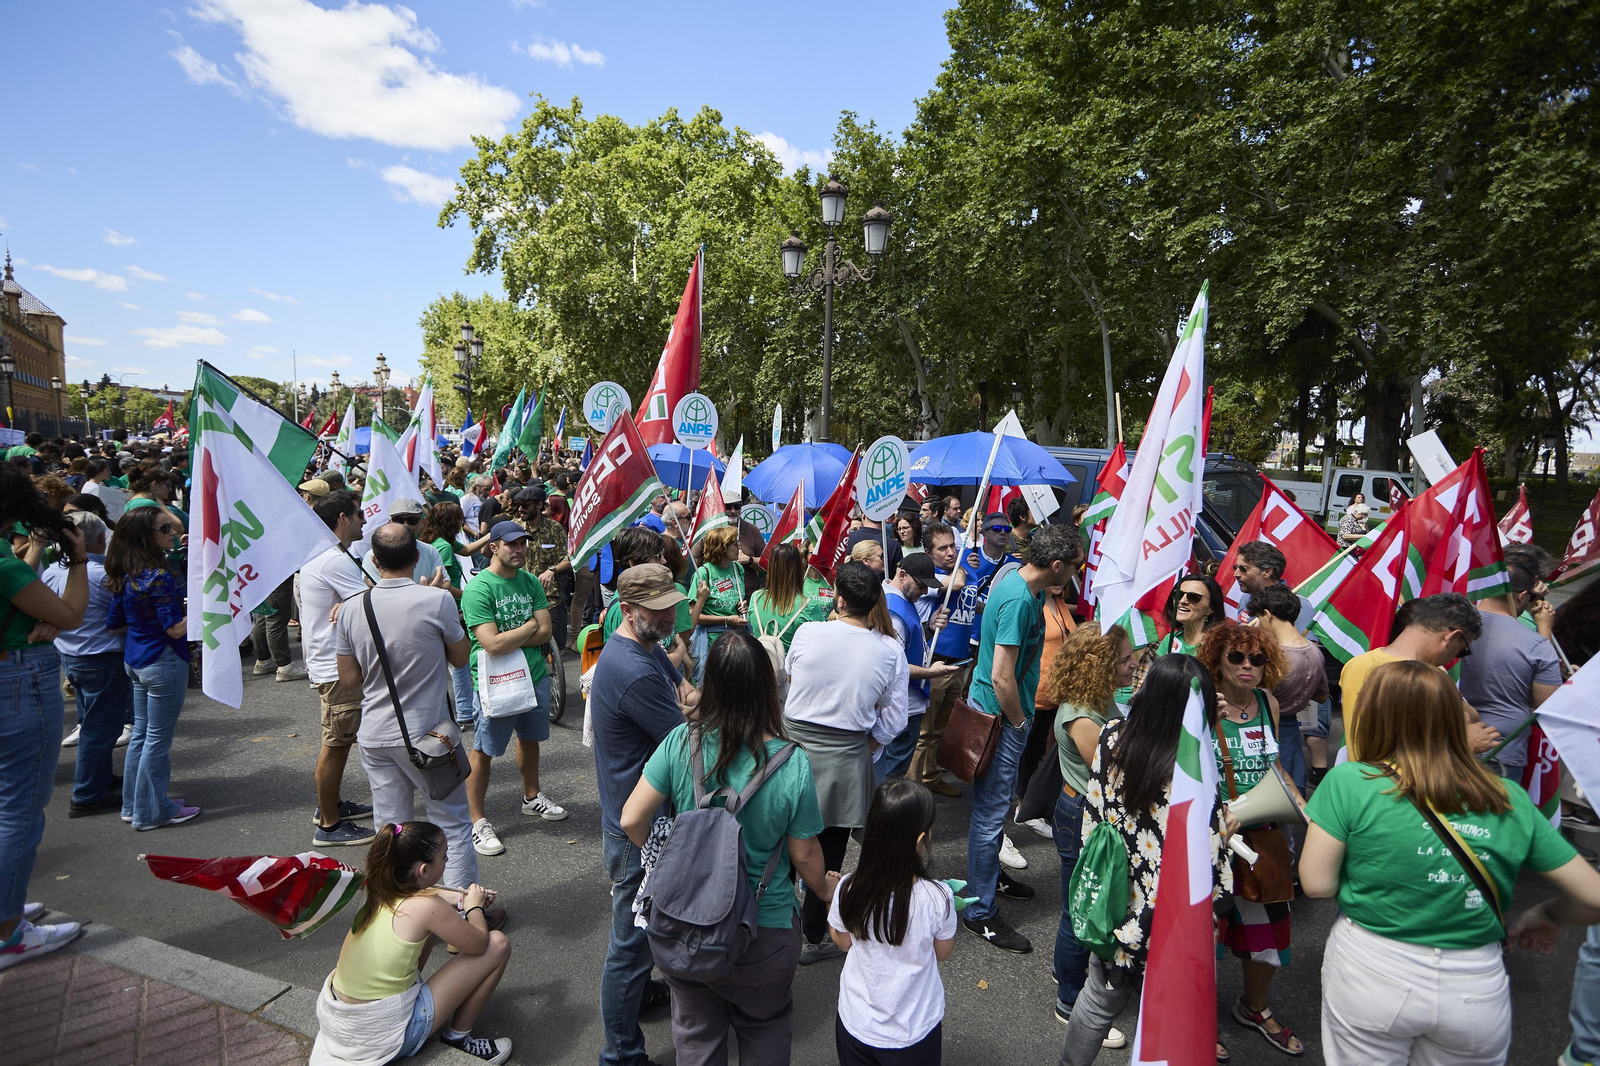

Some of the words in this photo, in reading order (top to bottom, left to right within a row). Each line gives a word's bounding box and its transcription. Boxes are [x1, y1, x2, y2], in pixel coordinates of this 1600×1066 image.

[590, 409, 607, 420] AN
[678, 422, 712, 436] ANPE
[865, 471, 905, 507] ANPE
[950, 608, 976, 623] ANP
[1417, 847, 1433, 855] LA
